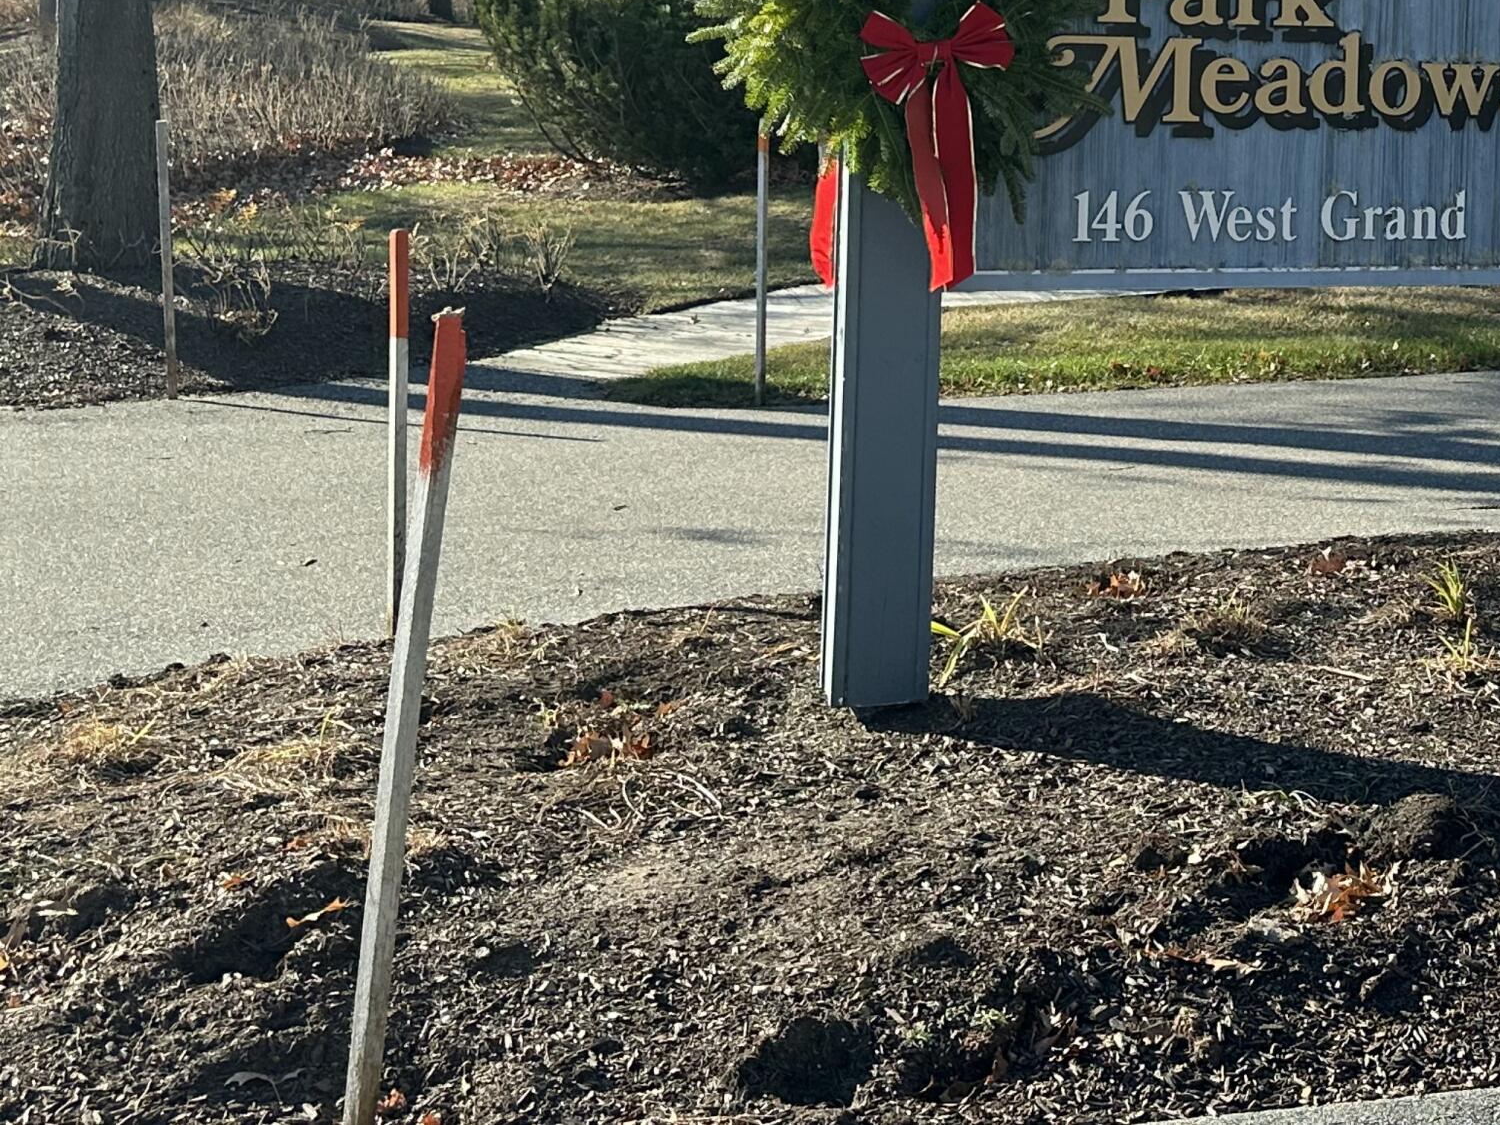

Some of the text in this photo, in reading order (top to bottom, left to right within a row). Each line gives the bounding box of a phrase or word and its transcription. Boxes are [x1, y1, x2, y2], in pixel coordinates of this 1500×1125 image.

[1070, 187, 1468, 244] 146 West Grand
